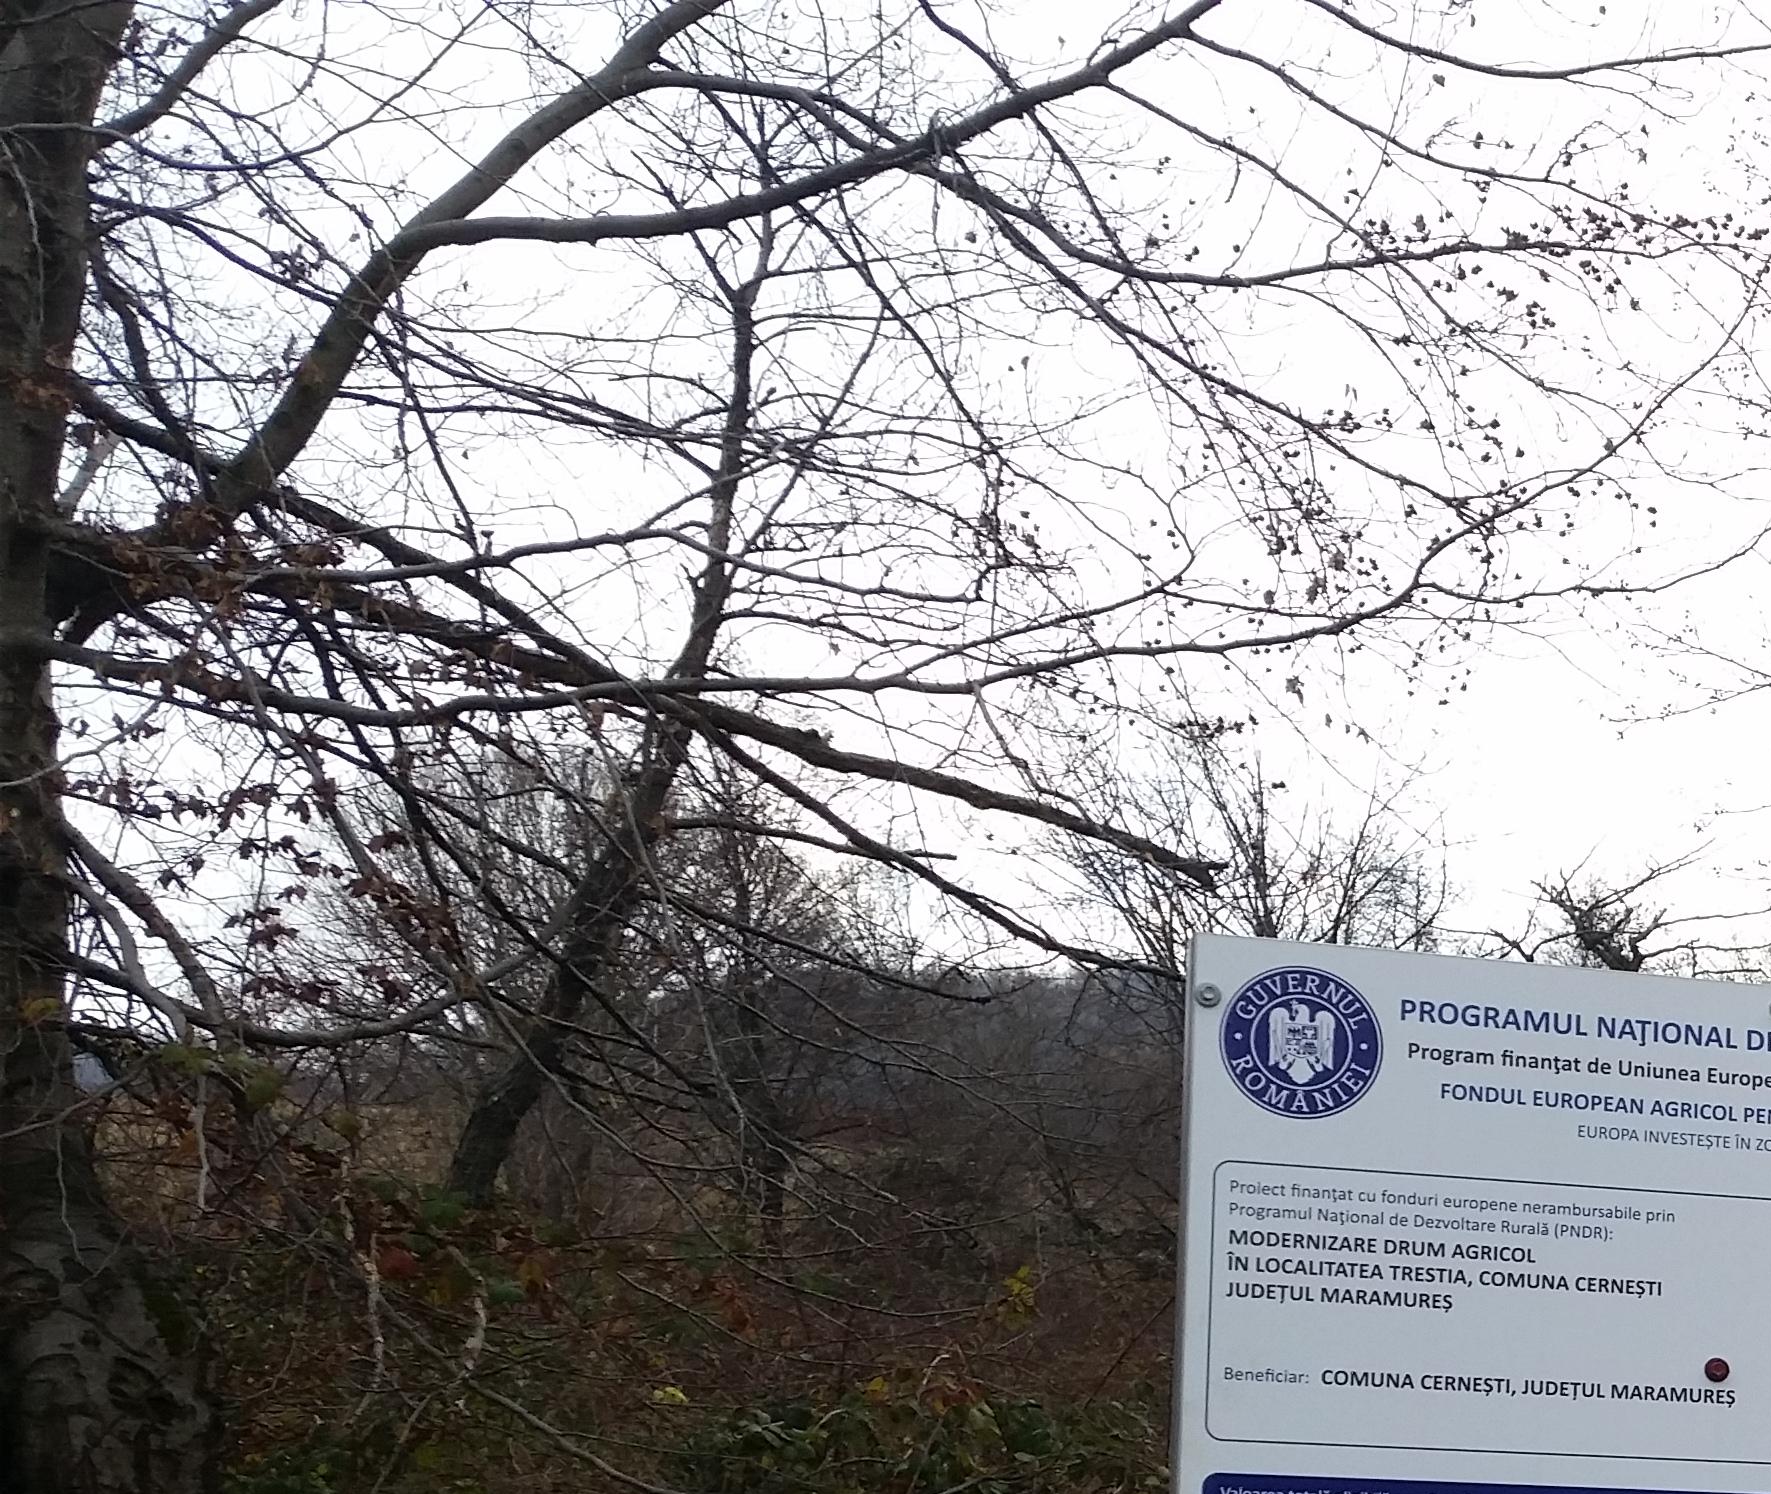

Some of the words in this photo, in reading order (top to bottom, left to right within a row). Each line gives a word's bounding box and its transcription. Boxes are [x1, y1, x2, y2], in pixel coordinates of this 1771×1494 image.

[1236, 974, 1368, 1029] GUVERNUL
[1400, 999, 1588, 1037] PROGRAMUL
[1408, 1042, 1495, 1066] Program
[1587, 1057, 1612, 1075] de
[1618, 1059, 1700, 1082] Uniunea
[1231, 1054, 1371, 1112] ROMÂNIEI
[1440, 1083, 1527, 1106] FONDUL
[1533, 1090, 1644, 1115] EUROPEAN
[1649, 1100, 1738, 1122] AGRICOL
[1577, 1124, 1640, 1142] EUROPA
[1734, 1133, 1751, 1150] ÎN
[1230, 1179, 1286, 1197] Proiect
[1358, 1191, 1376, 1203] cu
[1381, 1189, 1438, 1207] fonduri
[1443, 1197, 1518, 1213] europene
[1522, 1202, 1641, 1221] nerambursabile
[1646, 1209, 1675, 1224] prin
[1229, 1202, 1312, 1221] Programul
[1389, 1212, 1409, 1227] de
[1413, 1214, 1496, 1233] Dezvoltare
[1501, 1220, 1549, 1236] Rurală
[1554, 1223, 1614, 1243] (PNDR):
[1226, 1229, 1377, 1256] MODERNIZARE
[1383, 1239, 1446, 1258] DRUM
[1451, 1243, 1536, 1264] AGRICOL
[1226, 1251, 1249, 1272] ÎN
[1255, 1257, 1384, 1280] LOCALITATEA
[1388, 1265, 1473, 1288] TRESTIA,
[1479, 1270, 1570, 1291] COMUNA
[1224, 1366, 1309, 1384] Beneficiar:
[1321, 1369, 1415, 1390] COMUNA
